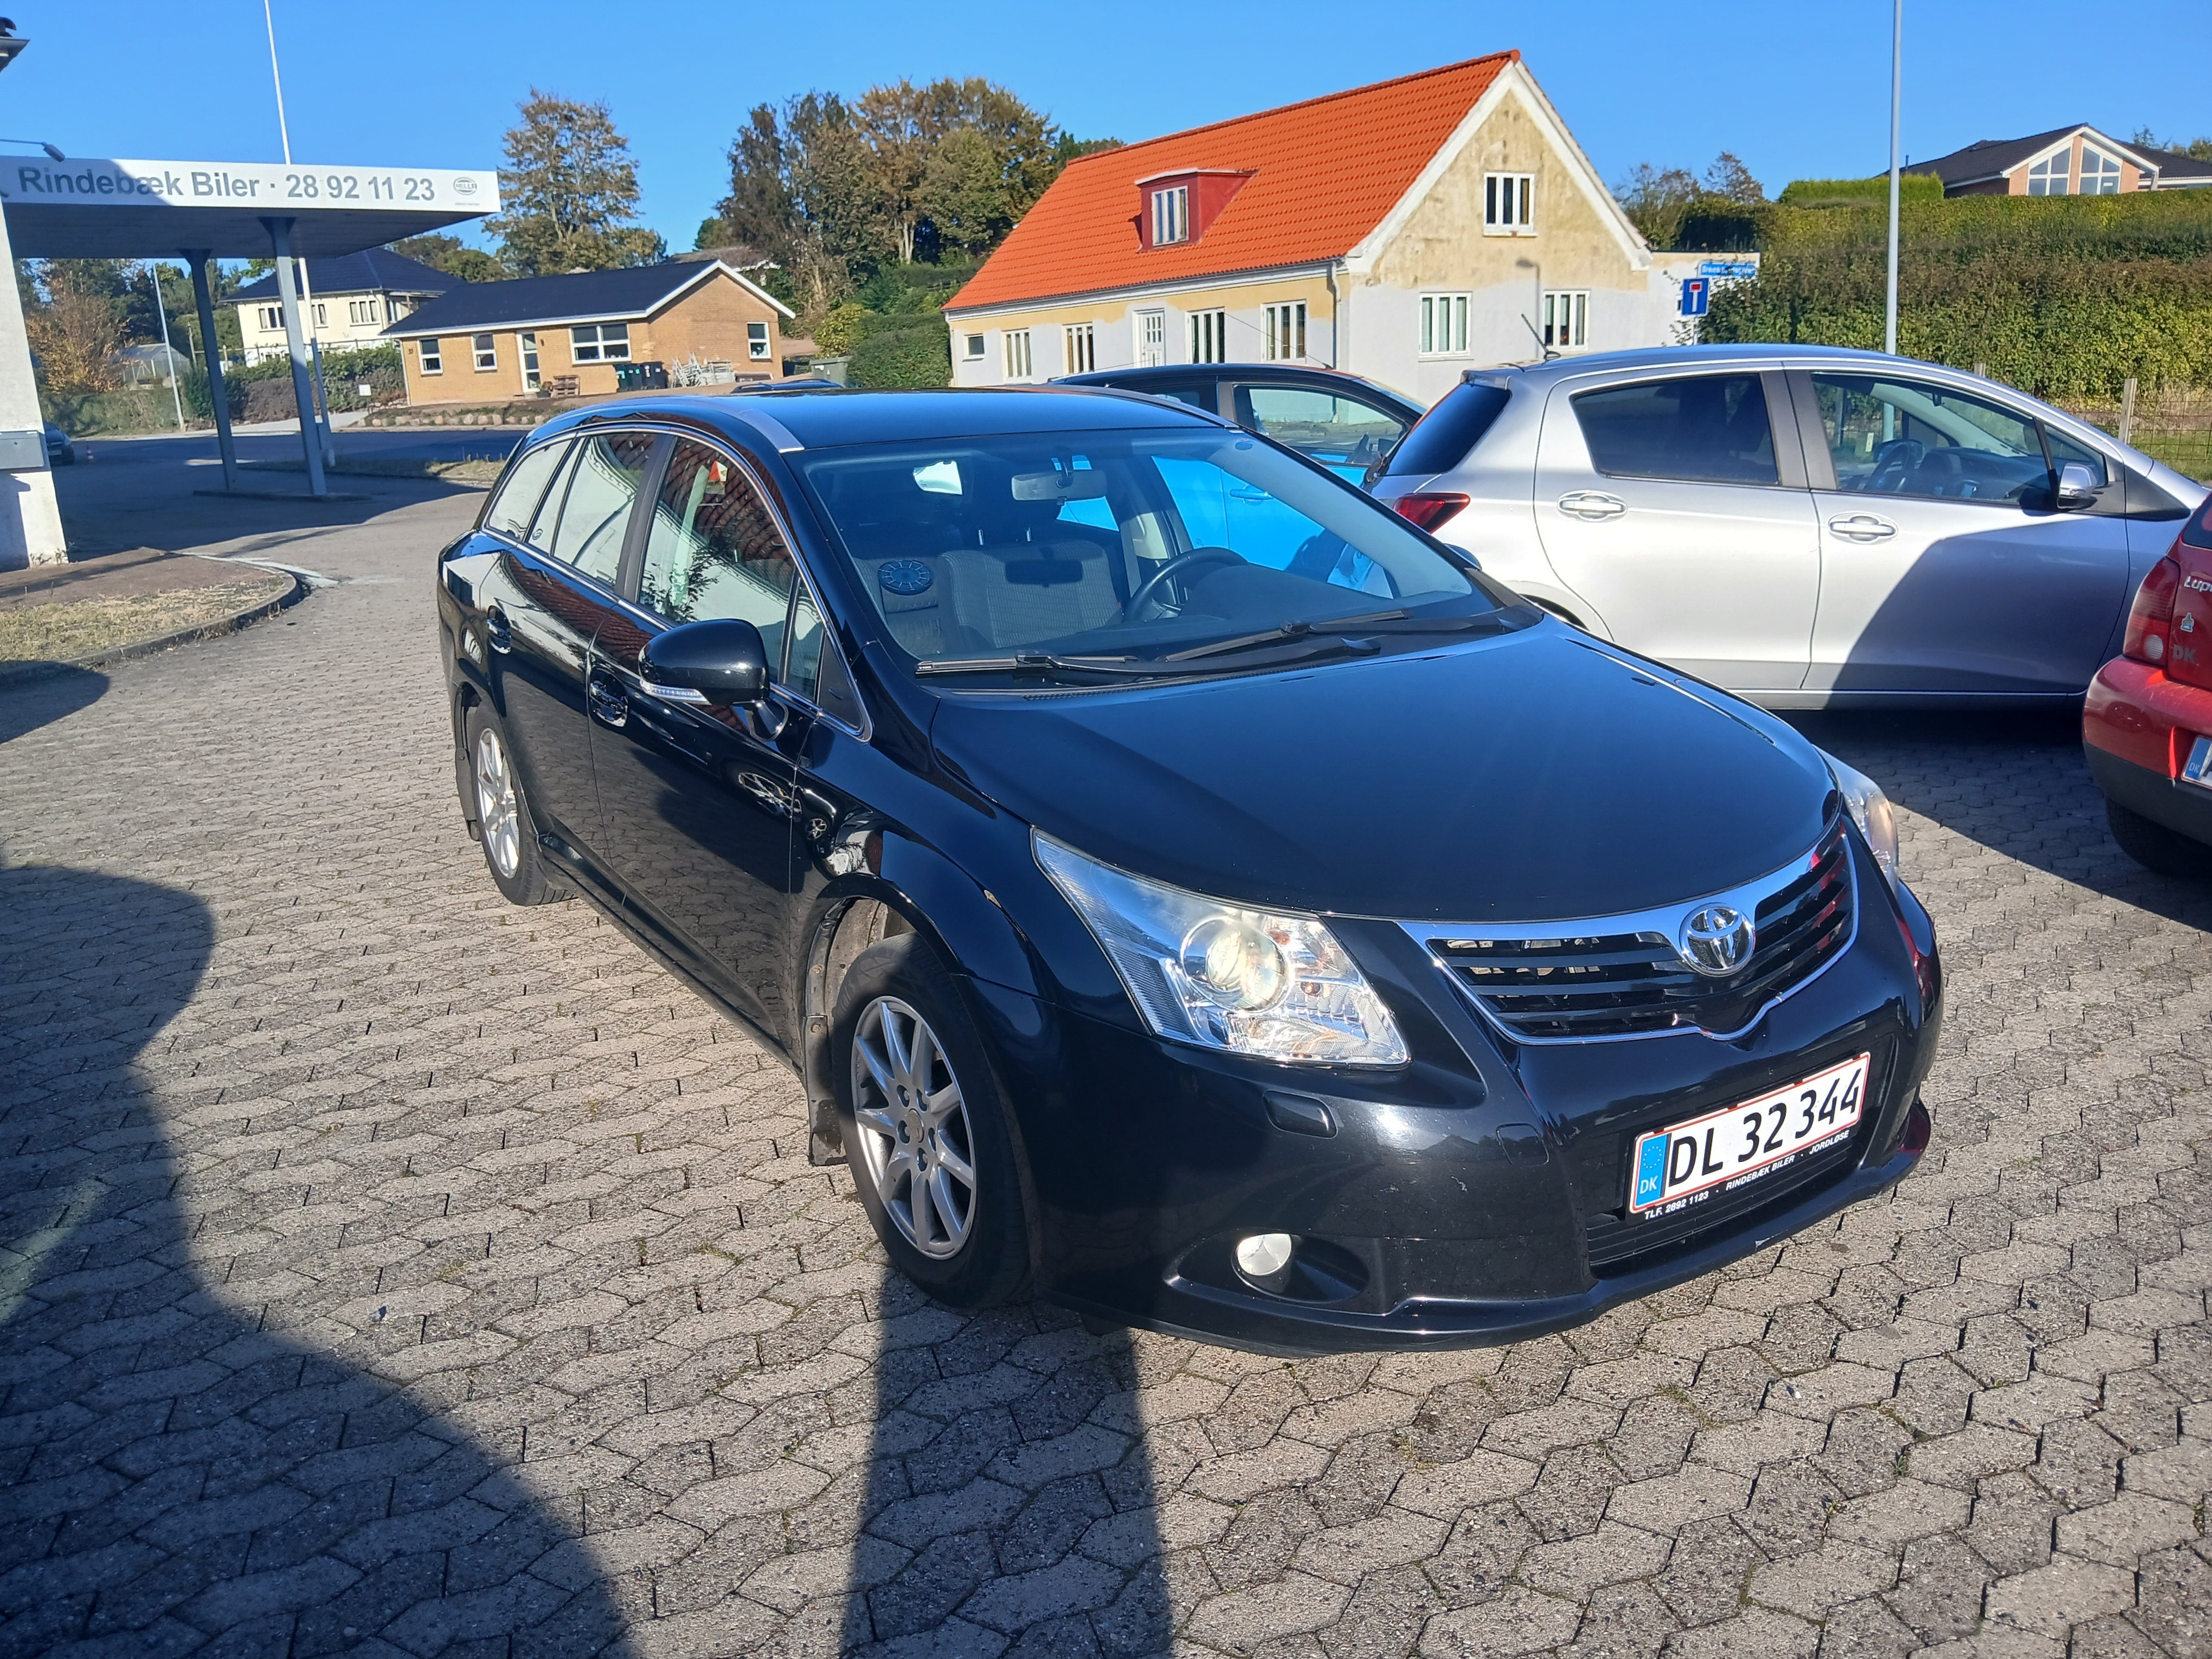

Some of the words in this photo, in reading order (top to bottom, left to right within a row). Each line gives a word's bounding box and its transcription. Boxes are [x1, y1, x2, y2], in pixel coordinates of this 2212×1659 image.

[18, 166, 184, 196] Rindebæk
[191, 171, 260, 197] Biler
[285, 174, 319, 198] 28
[326, 175, 360, 199] 92
[368, 176, 394, 200] 11
[403, 177, 435, 201] 23
[2184, 575, 2212, 593] Lup
[2172, 644, 2196, 664] DK
[2188, 762, 2201, 774] DK
[1668, 1127, 1724, 1187] DL
[1738, 1102, 1787, 1163] 32
[1795, 1068, 1862, 1140] 344
[1639, 1175, 1658, 1194] DK
[1644, 1206, 1663, 1220] TLF.
[1666, 1198, 1687, 1213] 2892
[1689, 1191, 1709, 1205] 1123
[1725, 1165, 1771, 1191] RINDEBÆK
[1771, 1154, 1796, 1172] BILER
[1809, 1129, 1850, 1155] JORDLØSE
